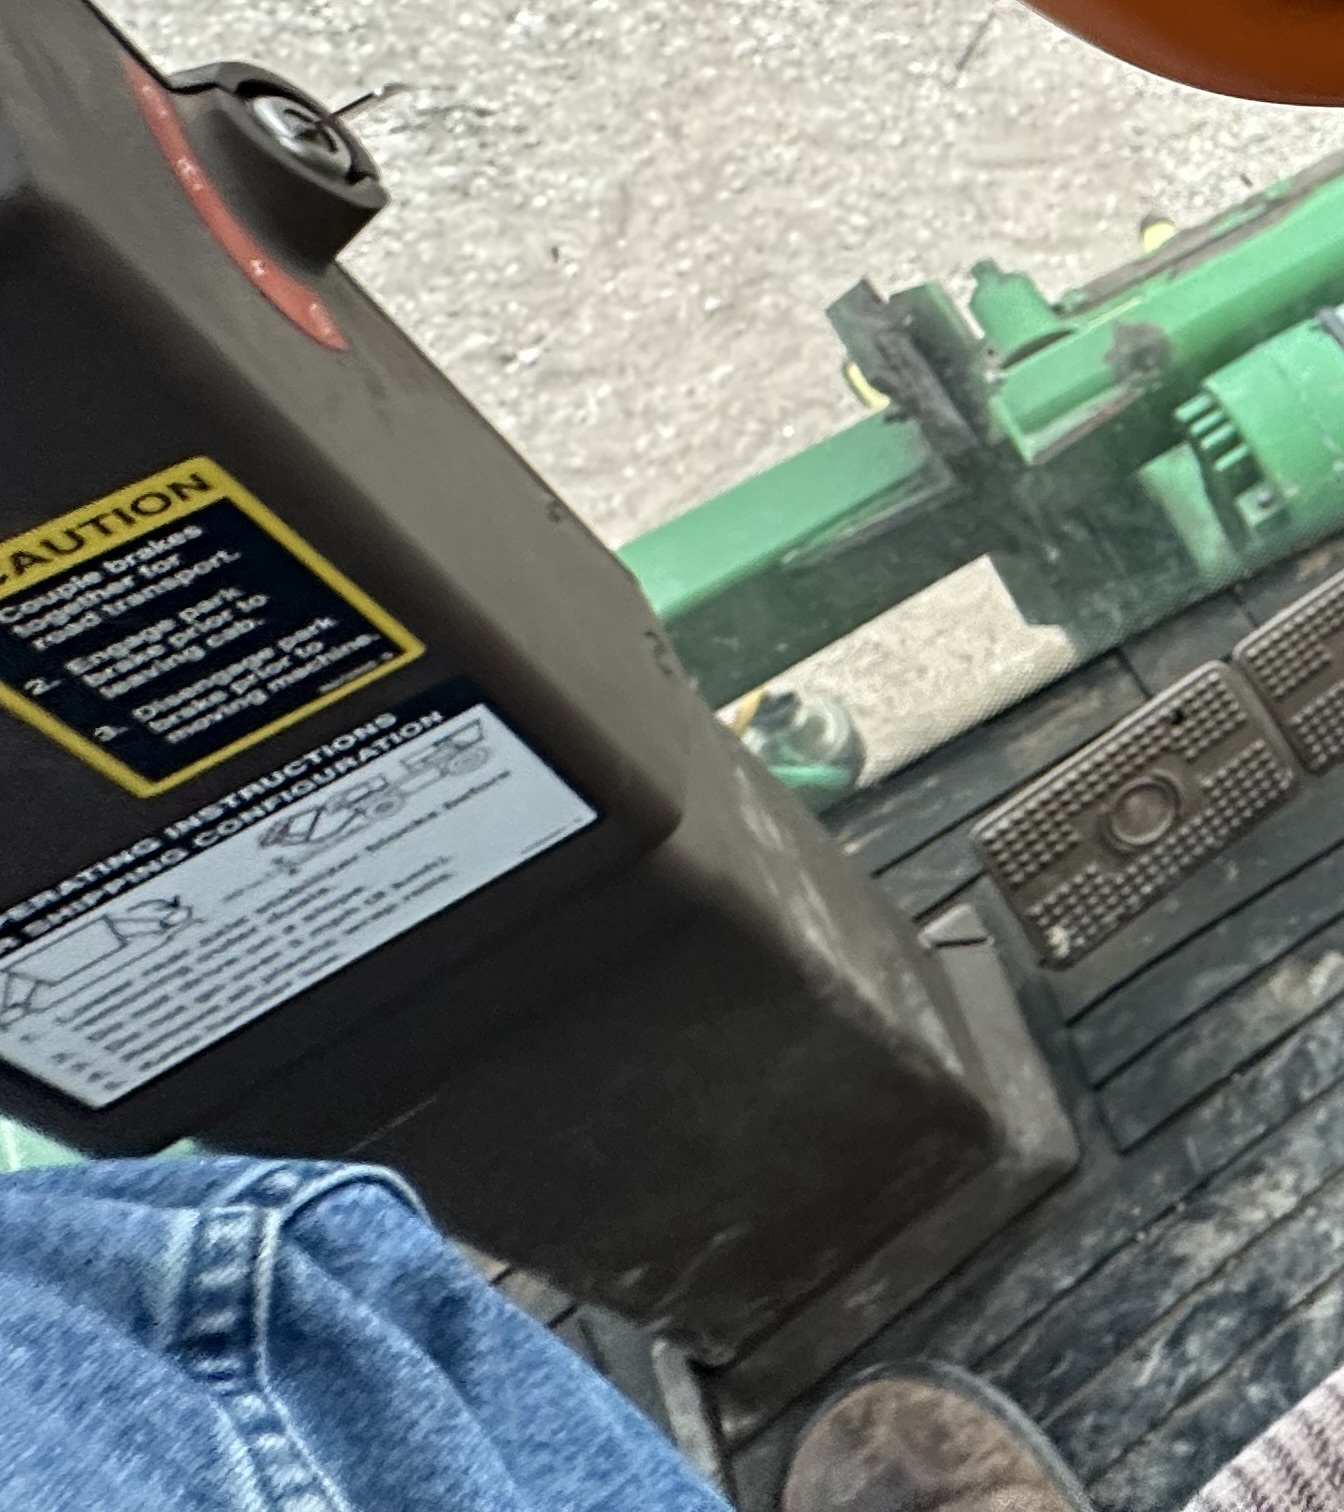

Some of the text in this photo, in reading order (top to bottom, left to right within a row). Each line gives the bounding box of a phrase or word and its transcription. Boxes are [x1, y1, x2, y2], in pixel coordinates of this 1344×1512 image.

[0, 471, 212, 585] AUTION
[103, 525, 203, 574] brakes
[13, 553, 181, 637] together for
[32, 549, 242, 651] road transport.
[64, 619, 176, 676] Engage
[178, 587, 245, 622] park
[82, 594, 269, 687] brake prior to
[99, 646, 206, 699] leaving
[132, 647, 275, 721] Disengage
[277, 617, 338, 652] park
[149, 690, 228, 733] brake
[230, 656, 292, 695] prior
[293, 641, 325, 660] to
[165, 688, 269, 744] moving
[163, 712, 397, 839] INSTRUCTIONS
[23, 710, 445, 936] SHIPPING CONFIGURATION
